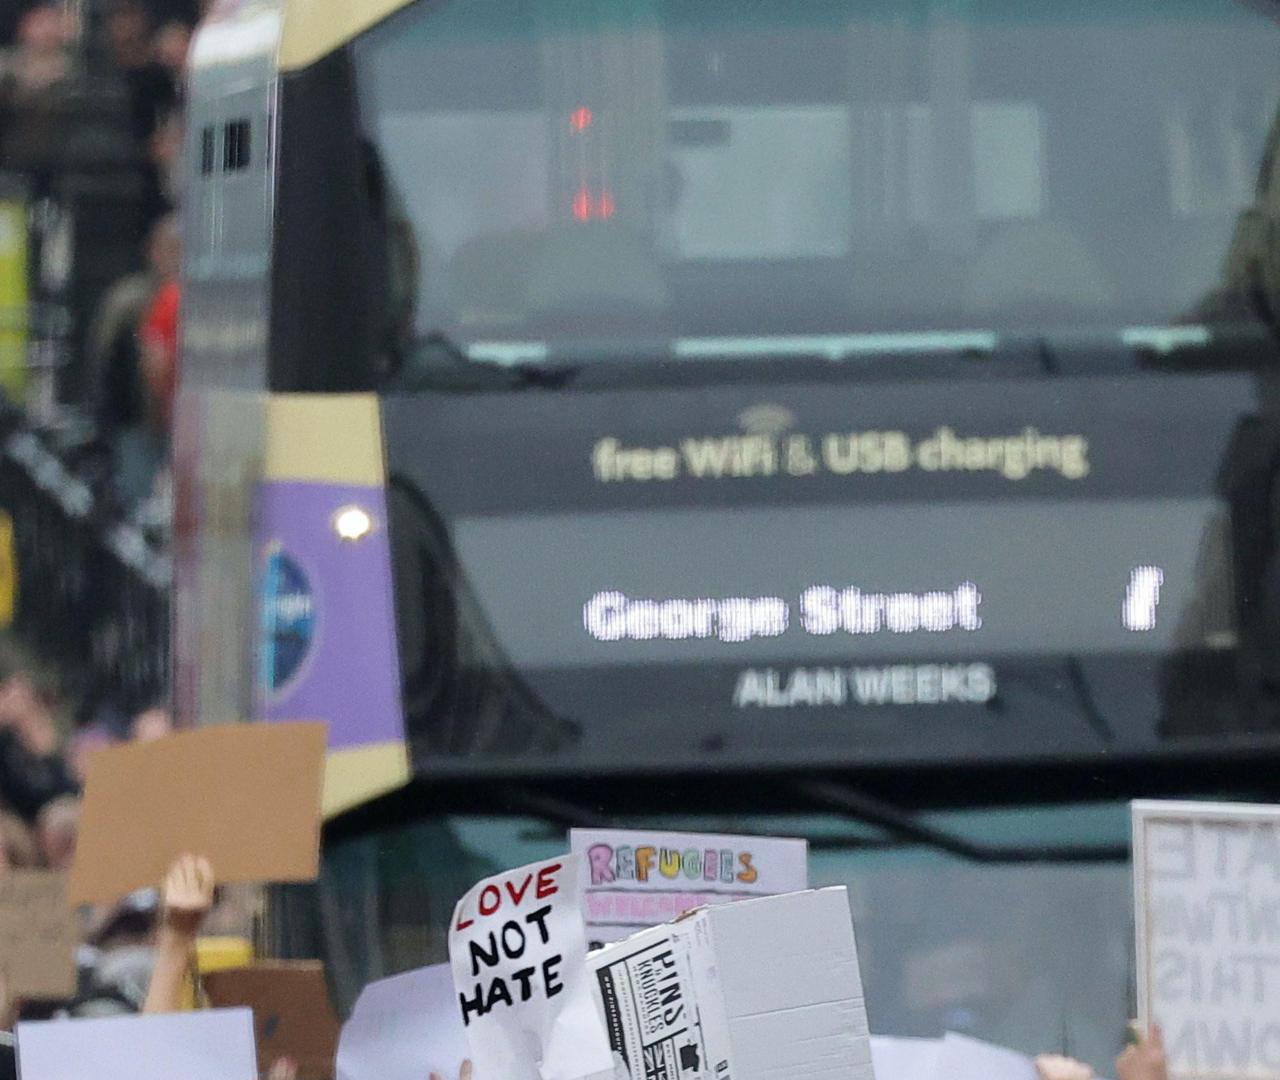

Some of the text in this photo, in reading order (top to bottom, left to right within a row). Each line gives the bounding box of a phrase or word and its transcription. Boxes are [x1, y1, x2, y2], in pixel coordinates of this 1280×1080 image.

[593, 427, 1089, 482] free WiFi & USB charging
[583, 582, 981, 642] George Street
[732, 663, 997, 707] ALAN WEEKS
[456, 864, 562, 932] LOVE
[587, 843, 758, 885] REFUGEES
[468, 904, 553, 977] NOT
[459, 954, 564, 1027] HATE
[637, 959, 665, 1034] KNUCKLES
[653, 950, 684, 1027] PINS
